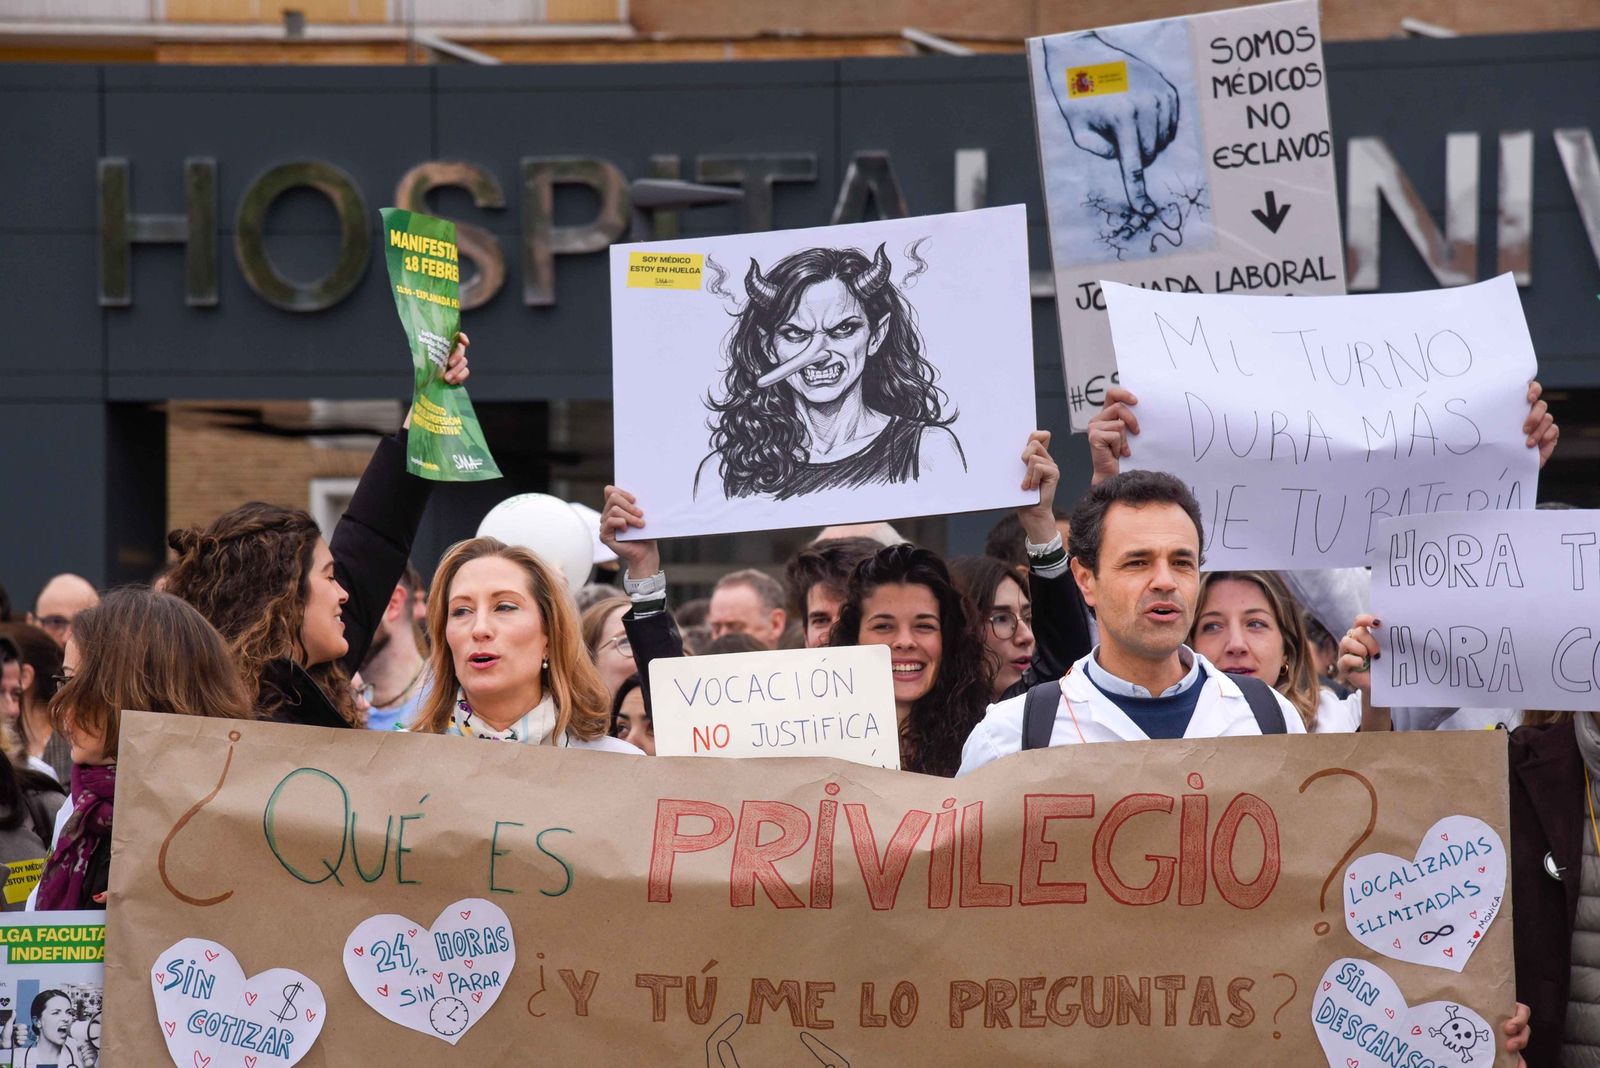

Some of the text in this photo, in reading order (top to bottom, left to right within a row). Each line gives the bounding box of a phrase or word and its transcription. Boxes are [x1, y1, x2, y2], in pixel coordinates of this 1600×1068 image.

[1210, 26, 1315, 64] SOMOS
[1212, 62, 1322, 99] MÉDICOS
[1246, 101, 1291, 130] NO
[1213, 130, 1330, 169] ESCLAVOS
[405, 256, 419, 272] 18
[660, 256, 691, 264] MÉDICO
[1216, 256, 1336, 293] LABORAL
[1272, 329, 1472, 390] TURNO
[1185, 391, 1481, 465] DURA MÁS
[1281, 487, 1347, 556] TU
[1389, 529, 1524, 589] HORA
[674, 658, 854, 707] VOCACIÓN
[1390, 625, 1524, 693] HORA
[692, 723, 731, 753] NO
[489, 820, 575, 897] ES
[1350, 837, 1493, 905] LOCALIZADAS
[1356, 880, 1481, 936] ILIMITADAS
[434, 926, 509, 962] HORAS
[448, 970, 501, 996] PARAR
[635, 958, 719, 1026] TÚ
[745, 977, 836, 1030] ME
[859, 979, 920, 1029] LO
[187, 1008, 294, 1060] COTIZAR
[1316, 997, 1449, 1068] DESCANS
